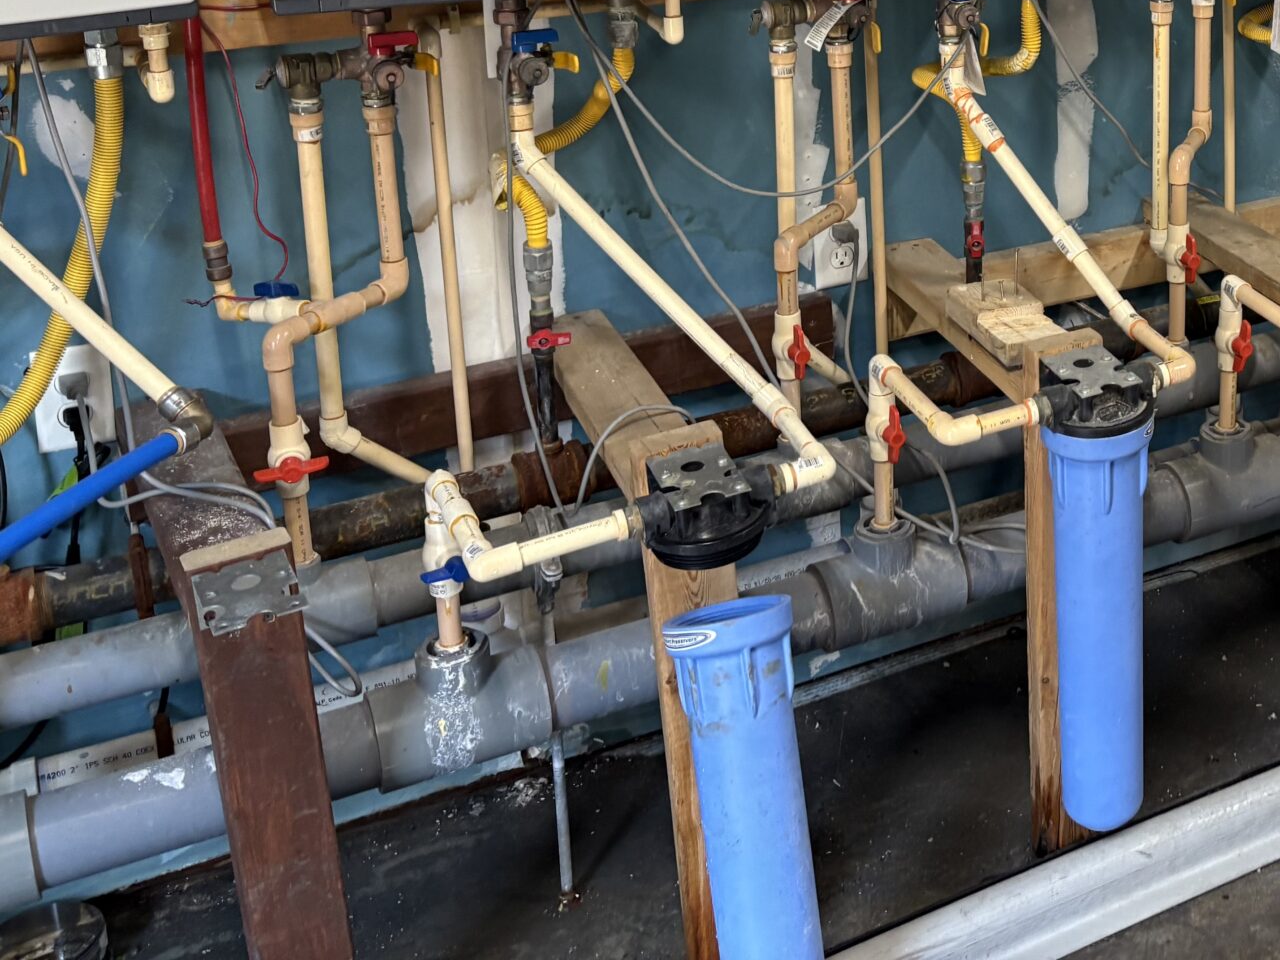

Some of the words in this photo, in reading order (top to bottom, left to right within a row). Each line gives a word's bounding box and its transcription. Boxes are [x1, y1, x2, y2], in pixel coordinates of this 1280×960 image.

[85, 758, 100, 770] IPS
[103, 754, 119, 764] SCH
[122, 751, 132, 760] 40
